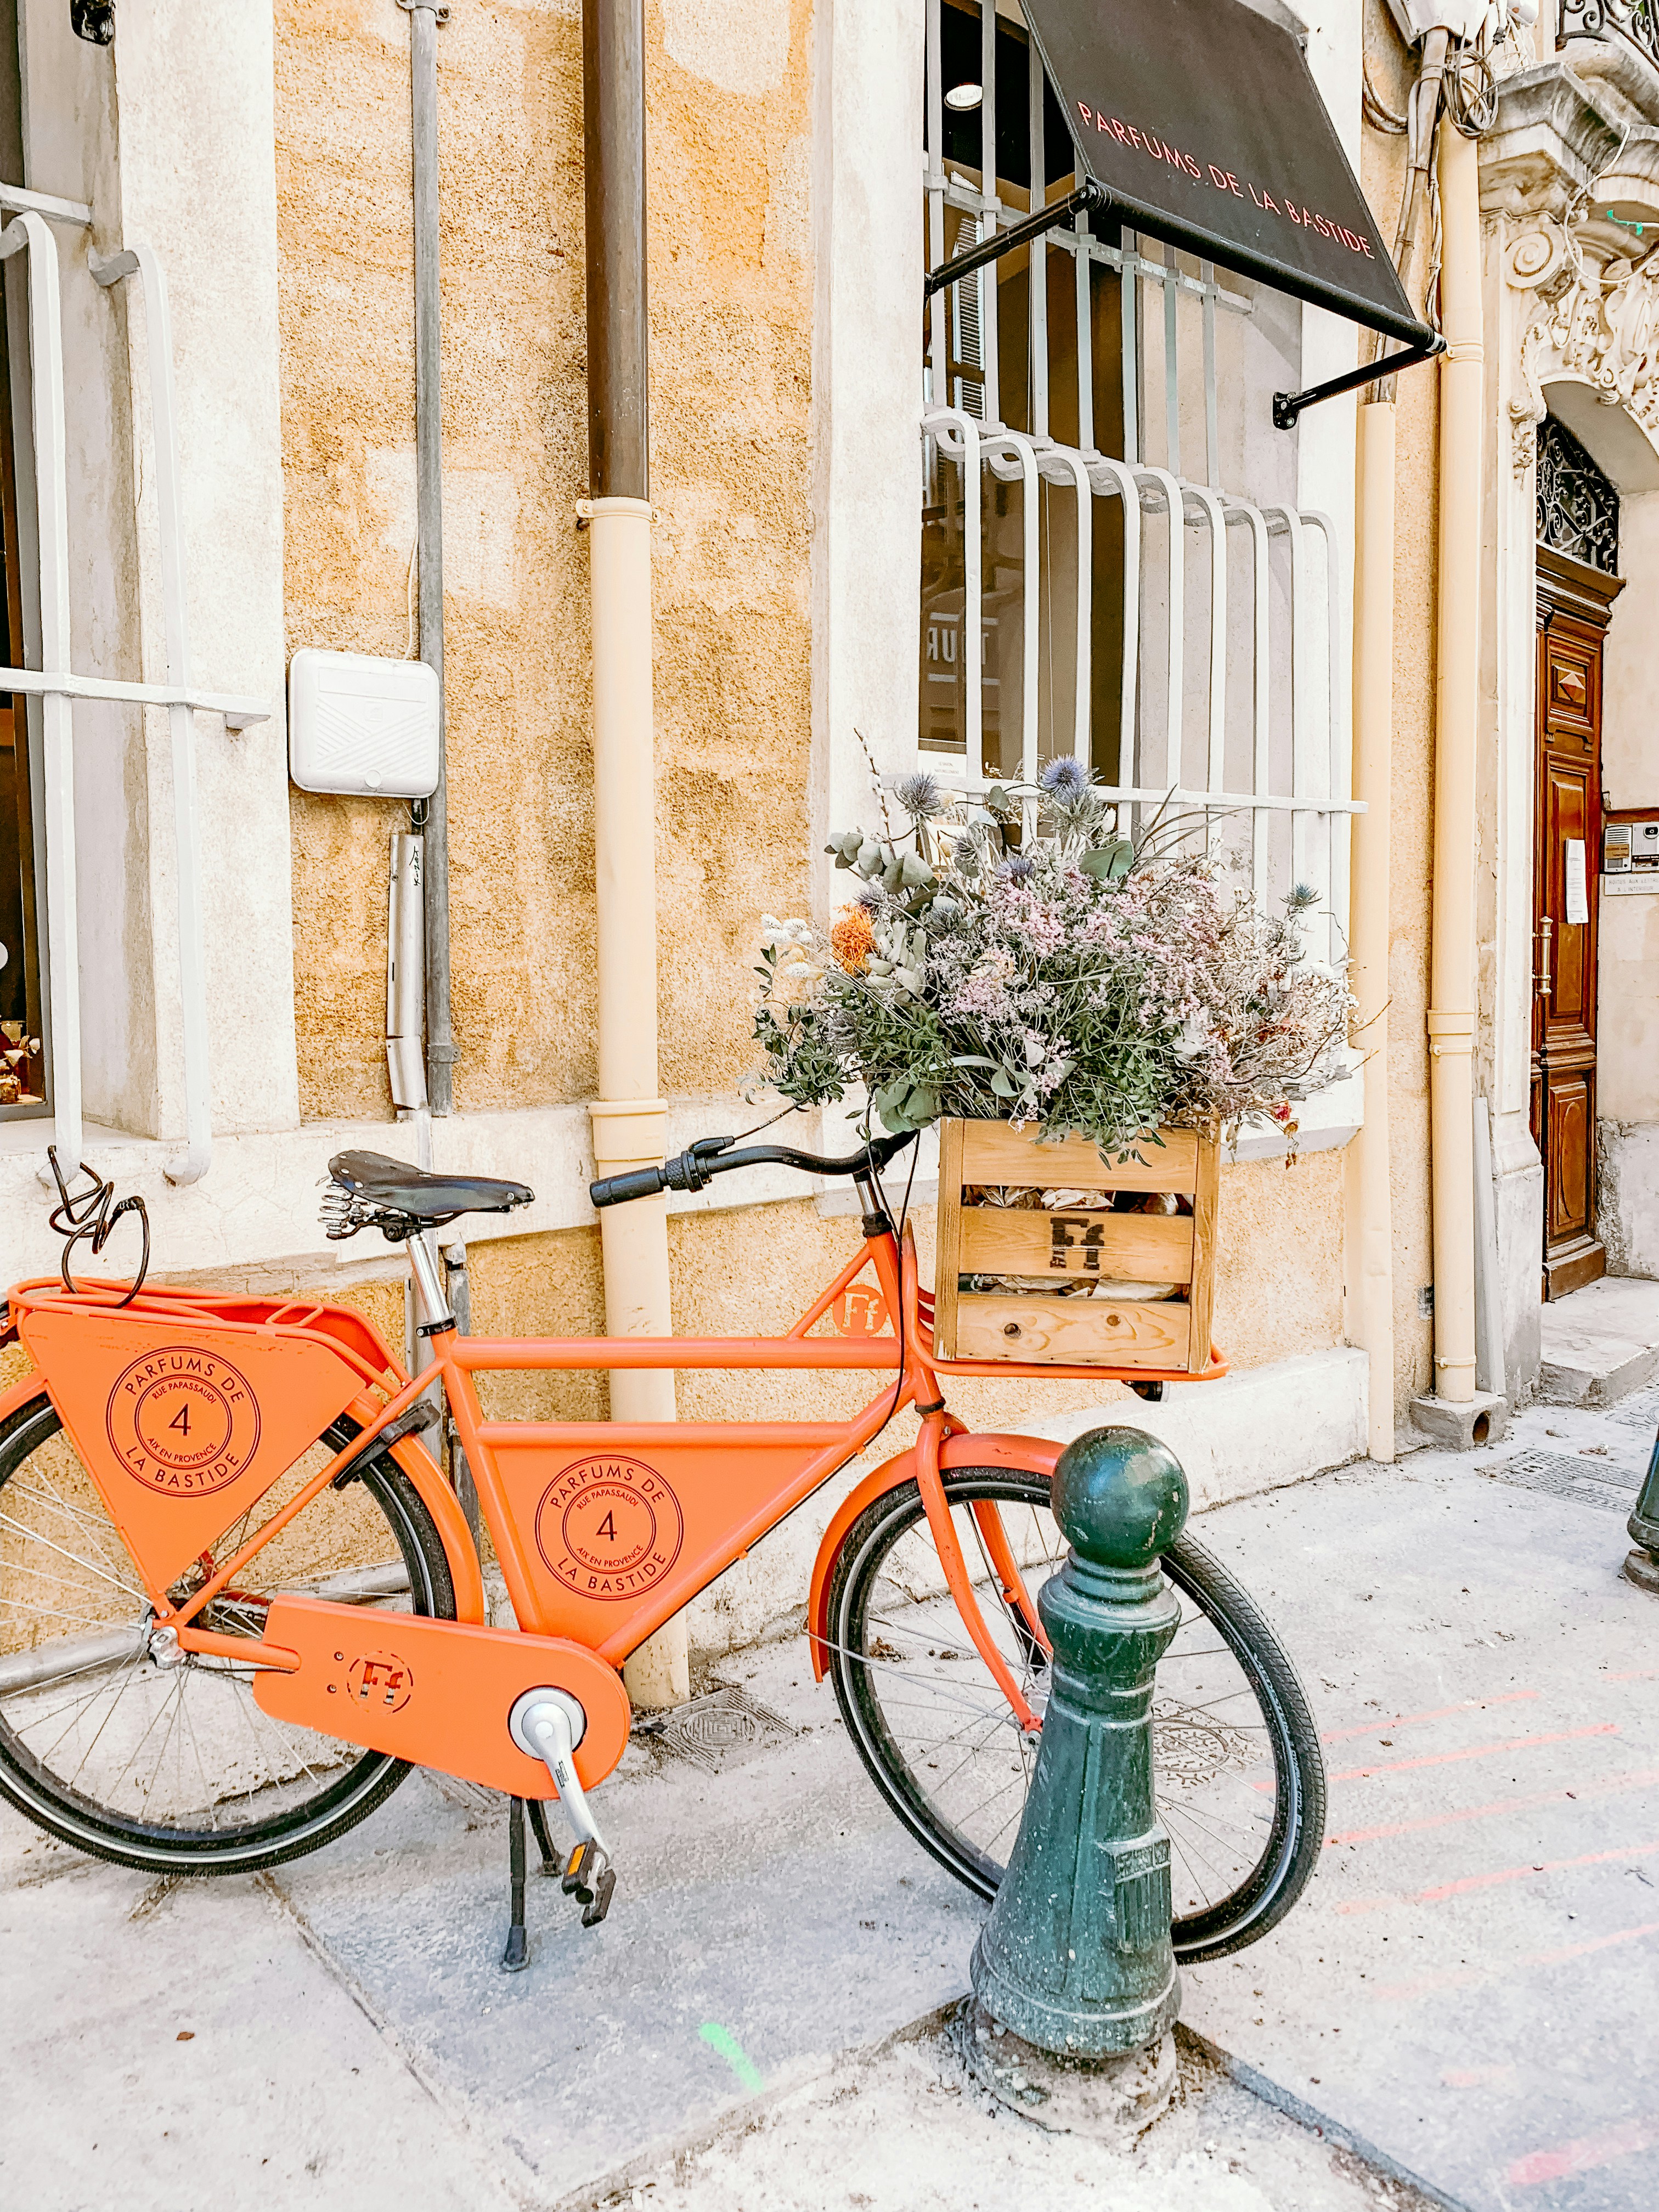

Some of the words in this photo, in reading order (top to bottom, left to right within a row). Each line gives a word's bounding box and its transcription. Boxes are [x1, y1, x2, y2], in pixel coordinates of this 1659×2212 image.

[1077, 100, 1202, 179] PARFUMS
[1208, 164, 1244, 198] DE
[1248, 183, 1281, 215] LA
[1284, 199, 1375, 260] BASTIDE
[125, 1356, 216, 1395] PARFUMS
[221, 1376, 244, 1403] DE
[151, 1387, 167, 1400] RUE
[168, 1381, 217, 1404] PAPASSAUDI
[168, 1403, 191, 1436] 4
[147, 1437, 160, 1452] AIX
[159, 1448, 172, 1460] EN
[173, 1442, 217, 1463] PROVENCE
[126, 1446, 146, 1471] LA
[155, 1452, 239, 1488] BASTIDE
[550, 1464, 634, 1508] PARFUMS
[641, 1478, 664, 1503] DE
[577, 1496, 591, 1510] RUE
[591, 1488, 639, 1508] PAPASSAUDI
[595, 1509, 617, 1542] 4
[557, 1558, 577, 1581] LA
[588, 1551, 666, 1592] BASTIDE
[576, 1547, 590, 1560] AIX
[590, 1556, 601, 1566] EN
[603, 1544, 644, 1567] PROVENCE
